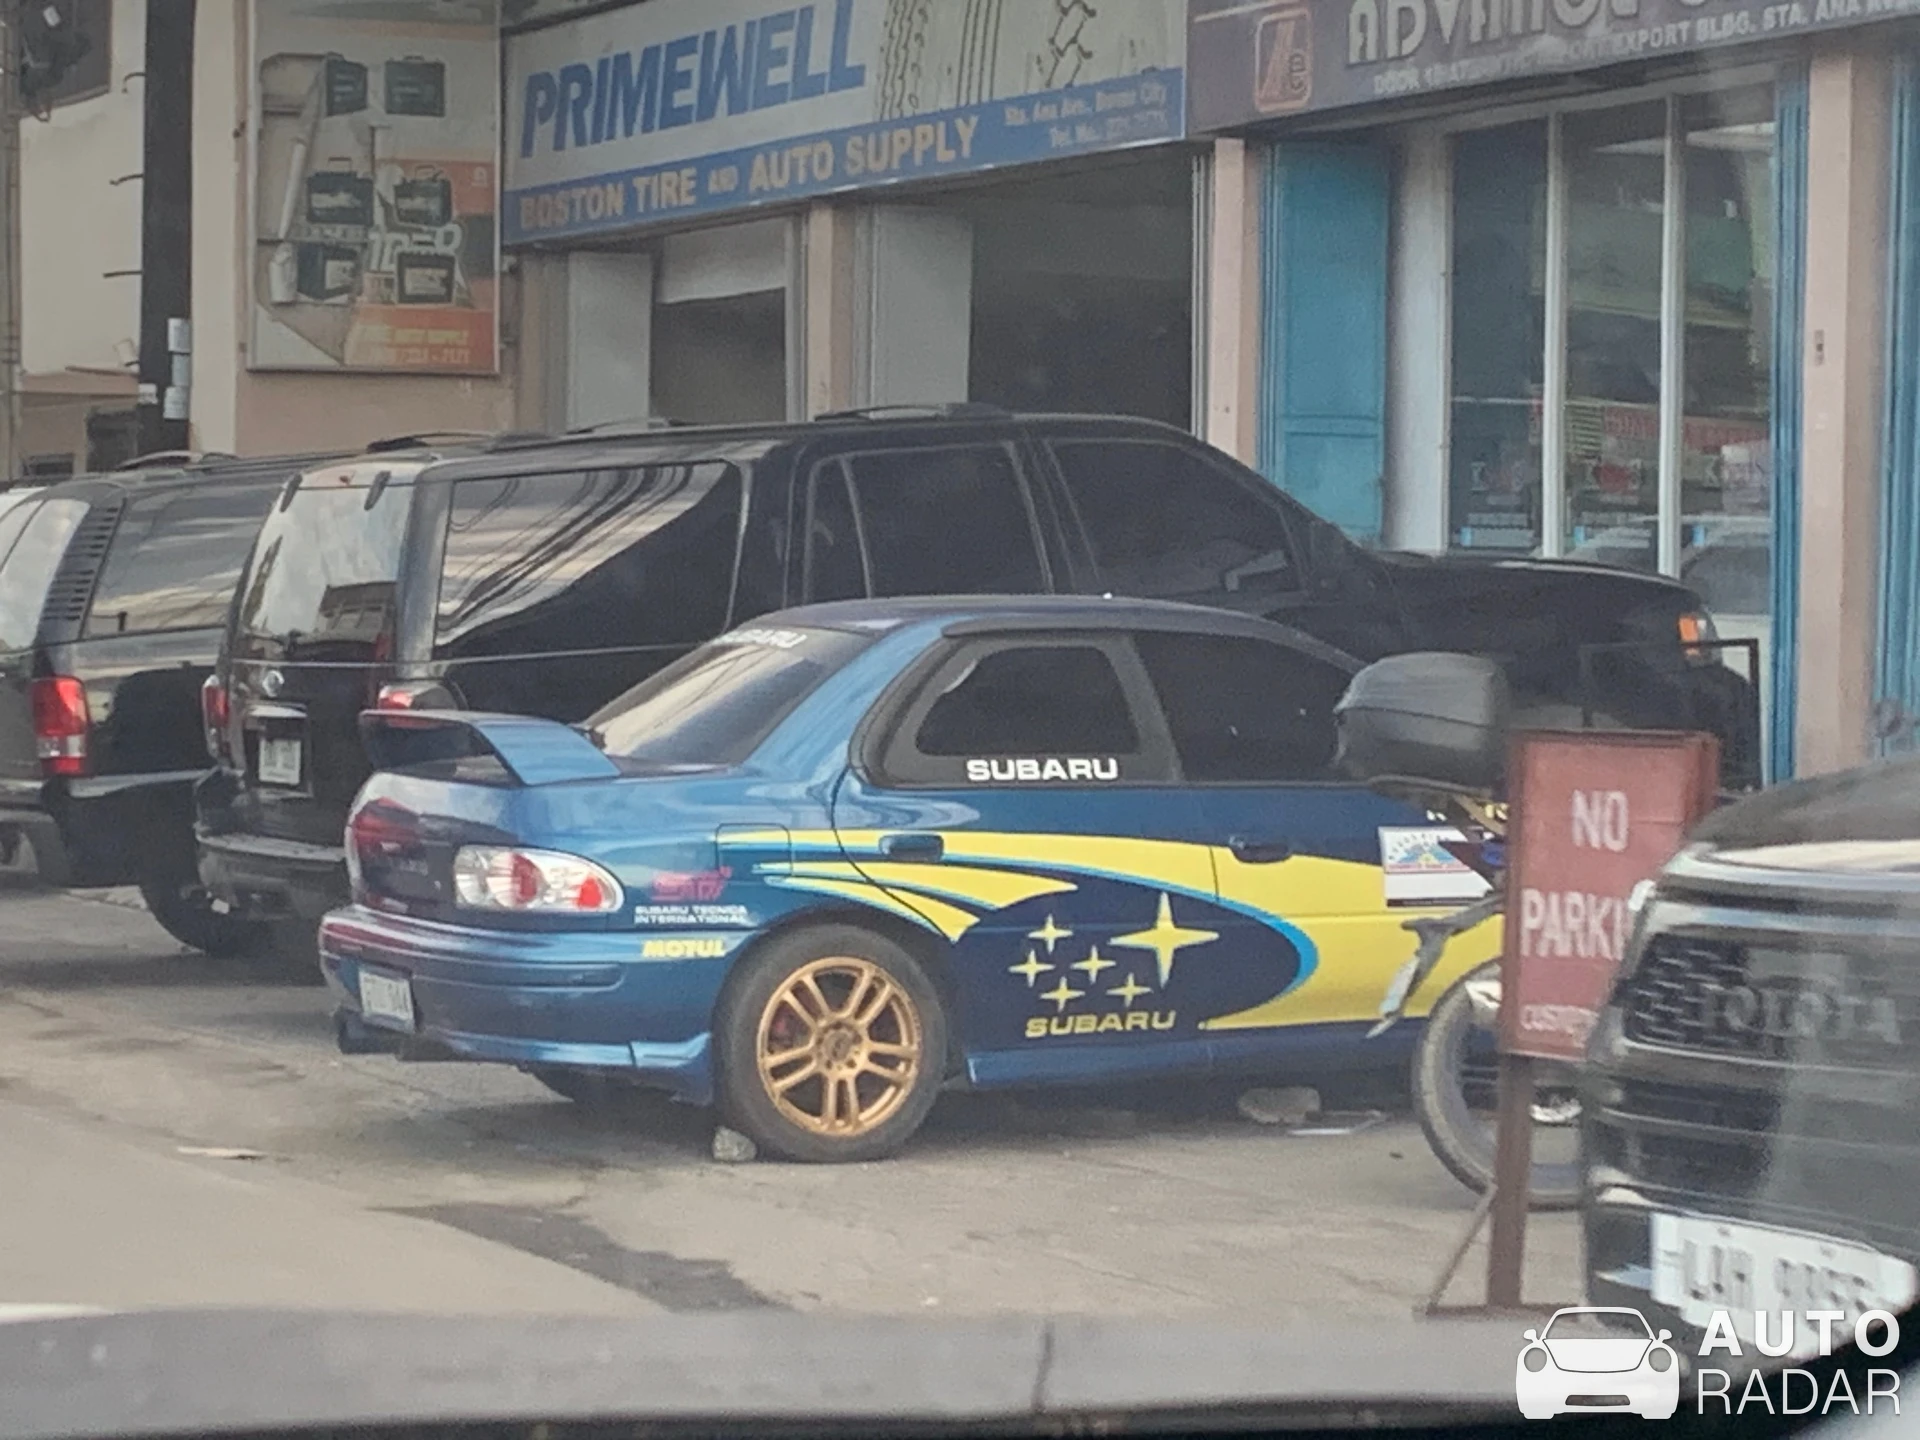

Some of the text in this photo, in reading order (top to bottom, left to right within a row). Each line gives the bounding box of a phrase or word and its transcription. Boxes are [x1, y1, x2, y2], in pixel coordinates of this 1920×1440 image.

[1348, 0, 1638, 64] ADVAN
[1611, 20, 1691, 52] EXPORT
[520, 0, 867, 158] PRIMEWELL
[519, 182, 625, 231] BOSTON
[632, 167, 698, 213] TIRE
[749, 140, 835, 193] AUTO
[845, 115, 979, 176] SUPPLY
[966, 757, 1119, 781] SUBARU
[1572, 788, 1629, 852] NO
[642, 939, 728, 958] MOTUL
[1024, 1010, 1177, 1038] SUBARU
